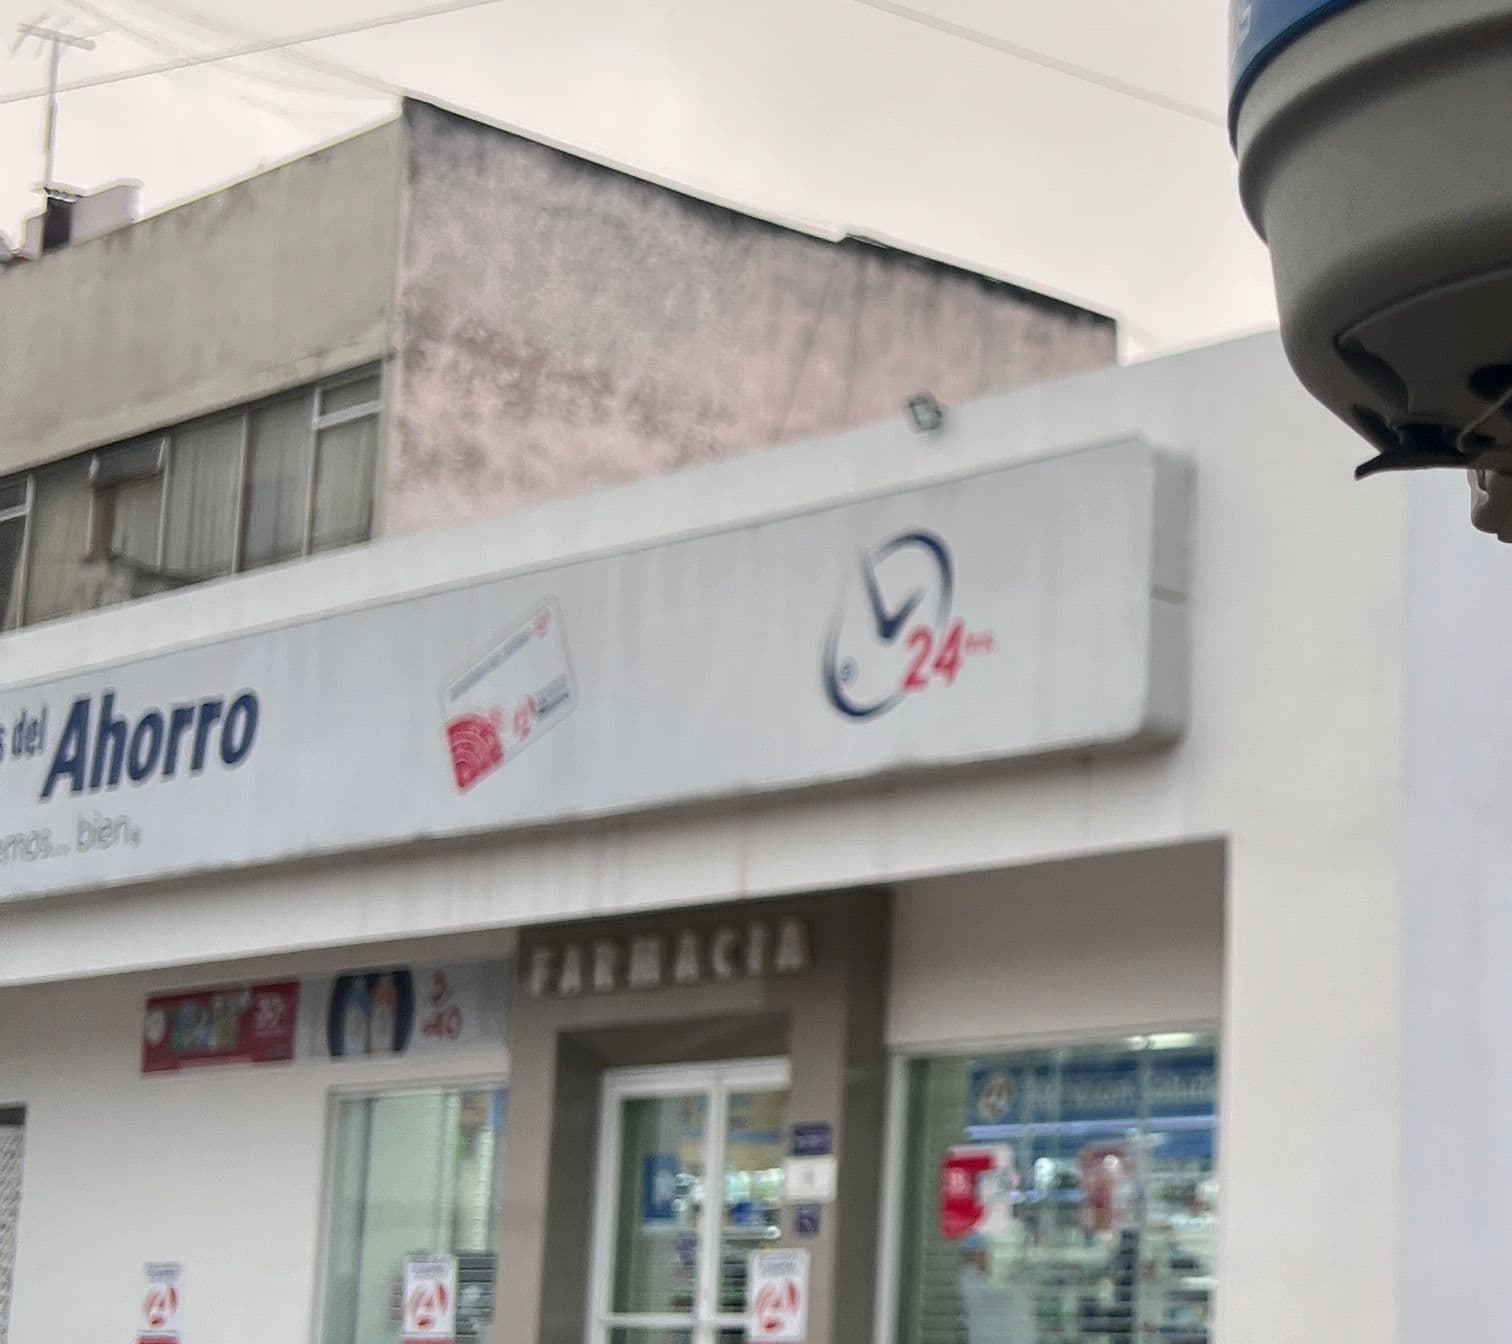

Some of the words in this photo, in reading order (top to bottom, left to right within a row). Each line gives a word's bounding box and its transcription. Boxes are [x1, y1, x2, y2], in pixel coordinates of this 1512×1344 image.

[11, 705, 49, 759] del
[38, 687, 261, 804] Ahorro
[527, 915, 806, 999] FARMACIA
